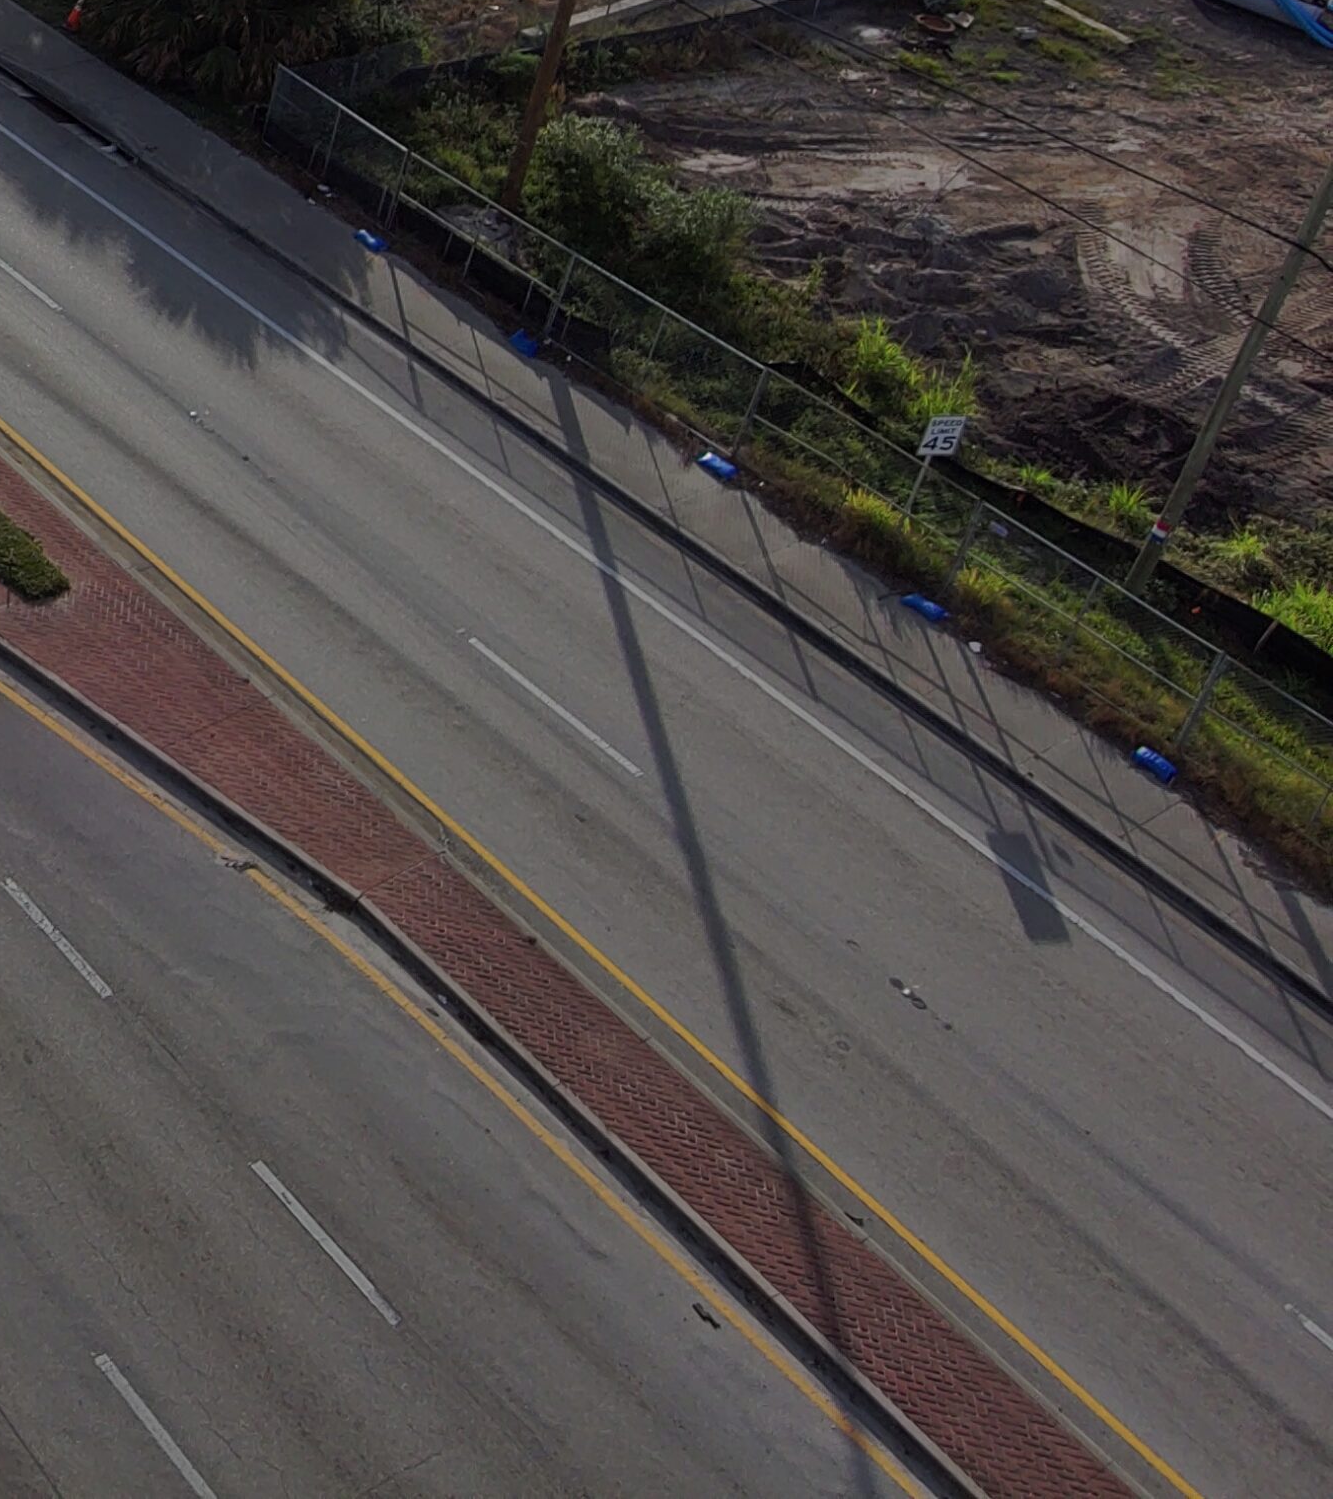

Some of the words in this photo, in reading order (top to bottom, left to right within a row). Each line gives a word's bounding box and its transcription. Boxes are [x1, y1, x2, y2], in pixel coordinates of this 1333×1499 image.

[932, 419, 964, 427] SPEED
[930, 427, 957, 435] LIMIT
[923, 436, 957, 451] 45
